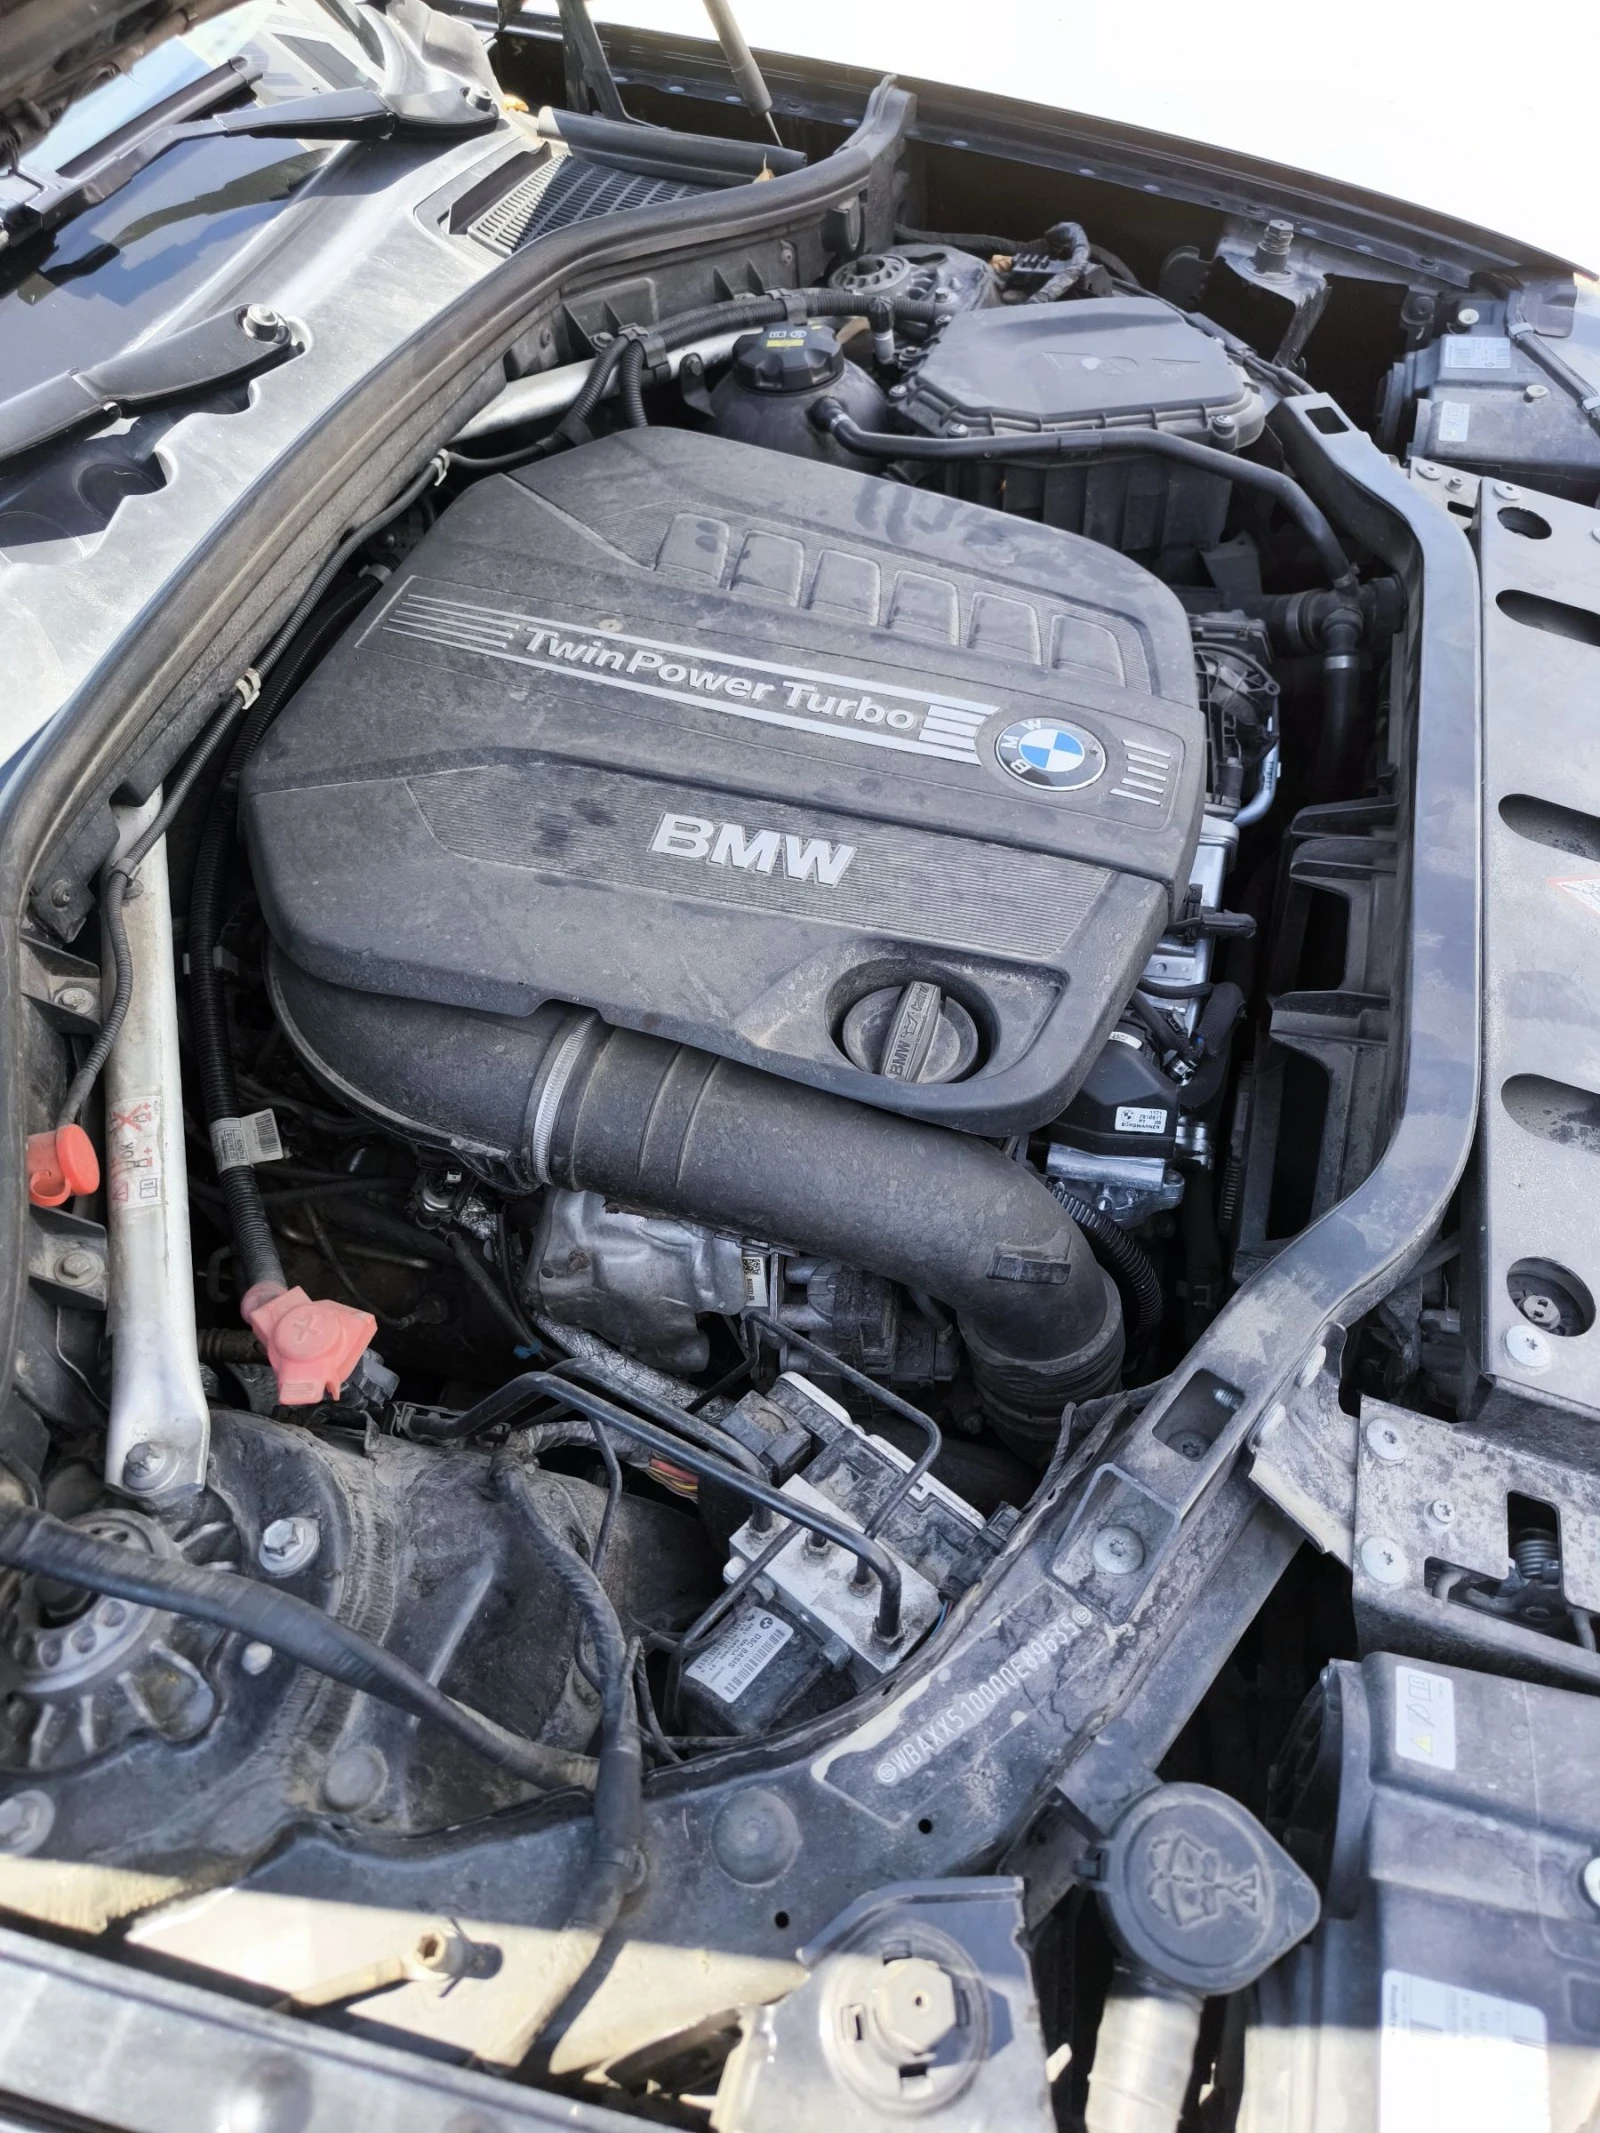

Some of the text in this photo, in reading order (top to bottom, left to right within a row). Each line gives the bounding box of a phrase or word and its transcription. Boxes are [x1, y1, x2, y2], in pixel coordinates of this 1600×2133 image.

[526, 626, 915, 730] TwinPower Turbo
[1000, 718, 1042, 775] BMW
[648, 811, 858, 888] BMW
[889, 1040, 911, 1076] BMW
[728, 1633, 762, 1669] DSC BASIS
